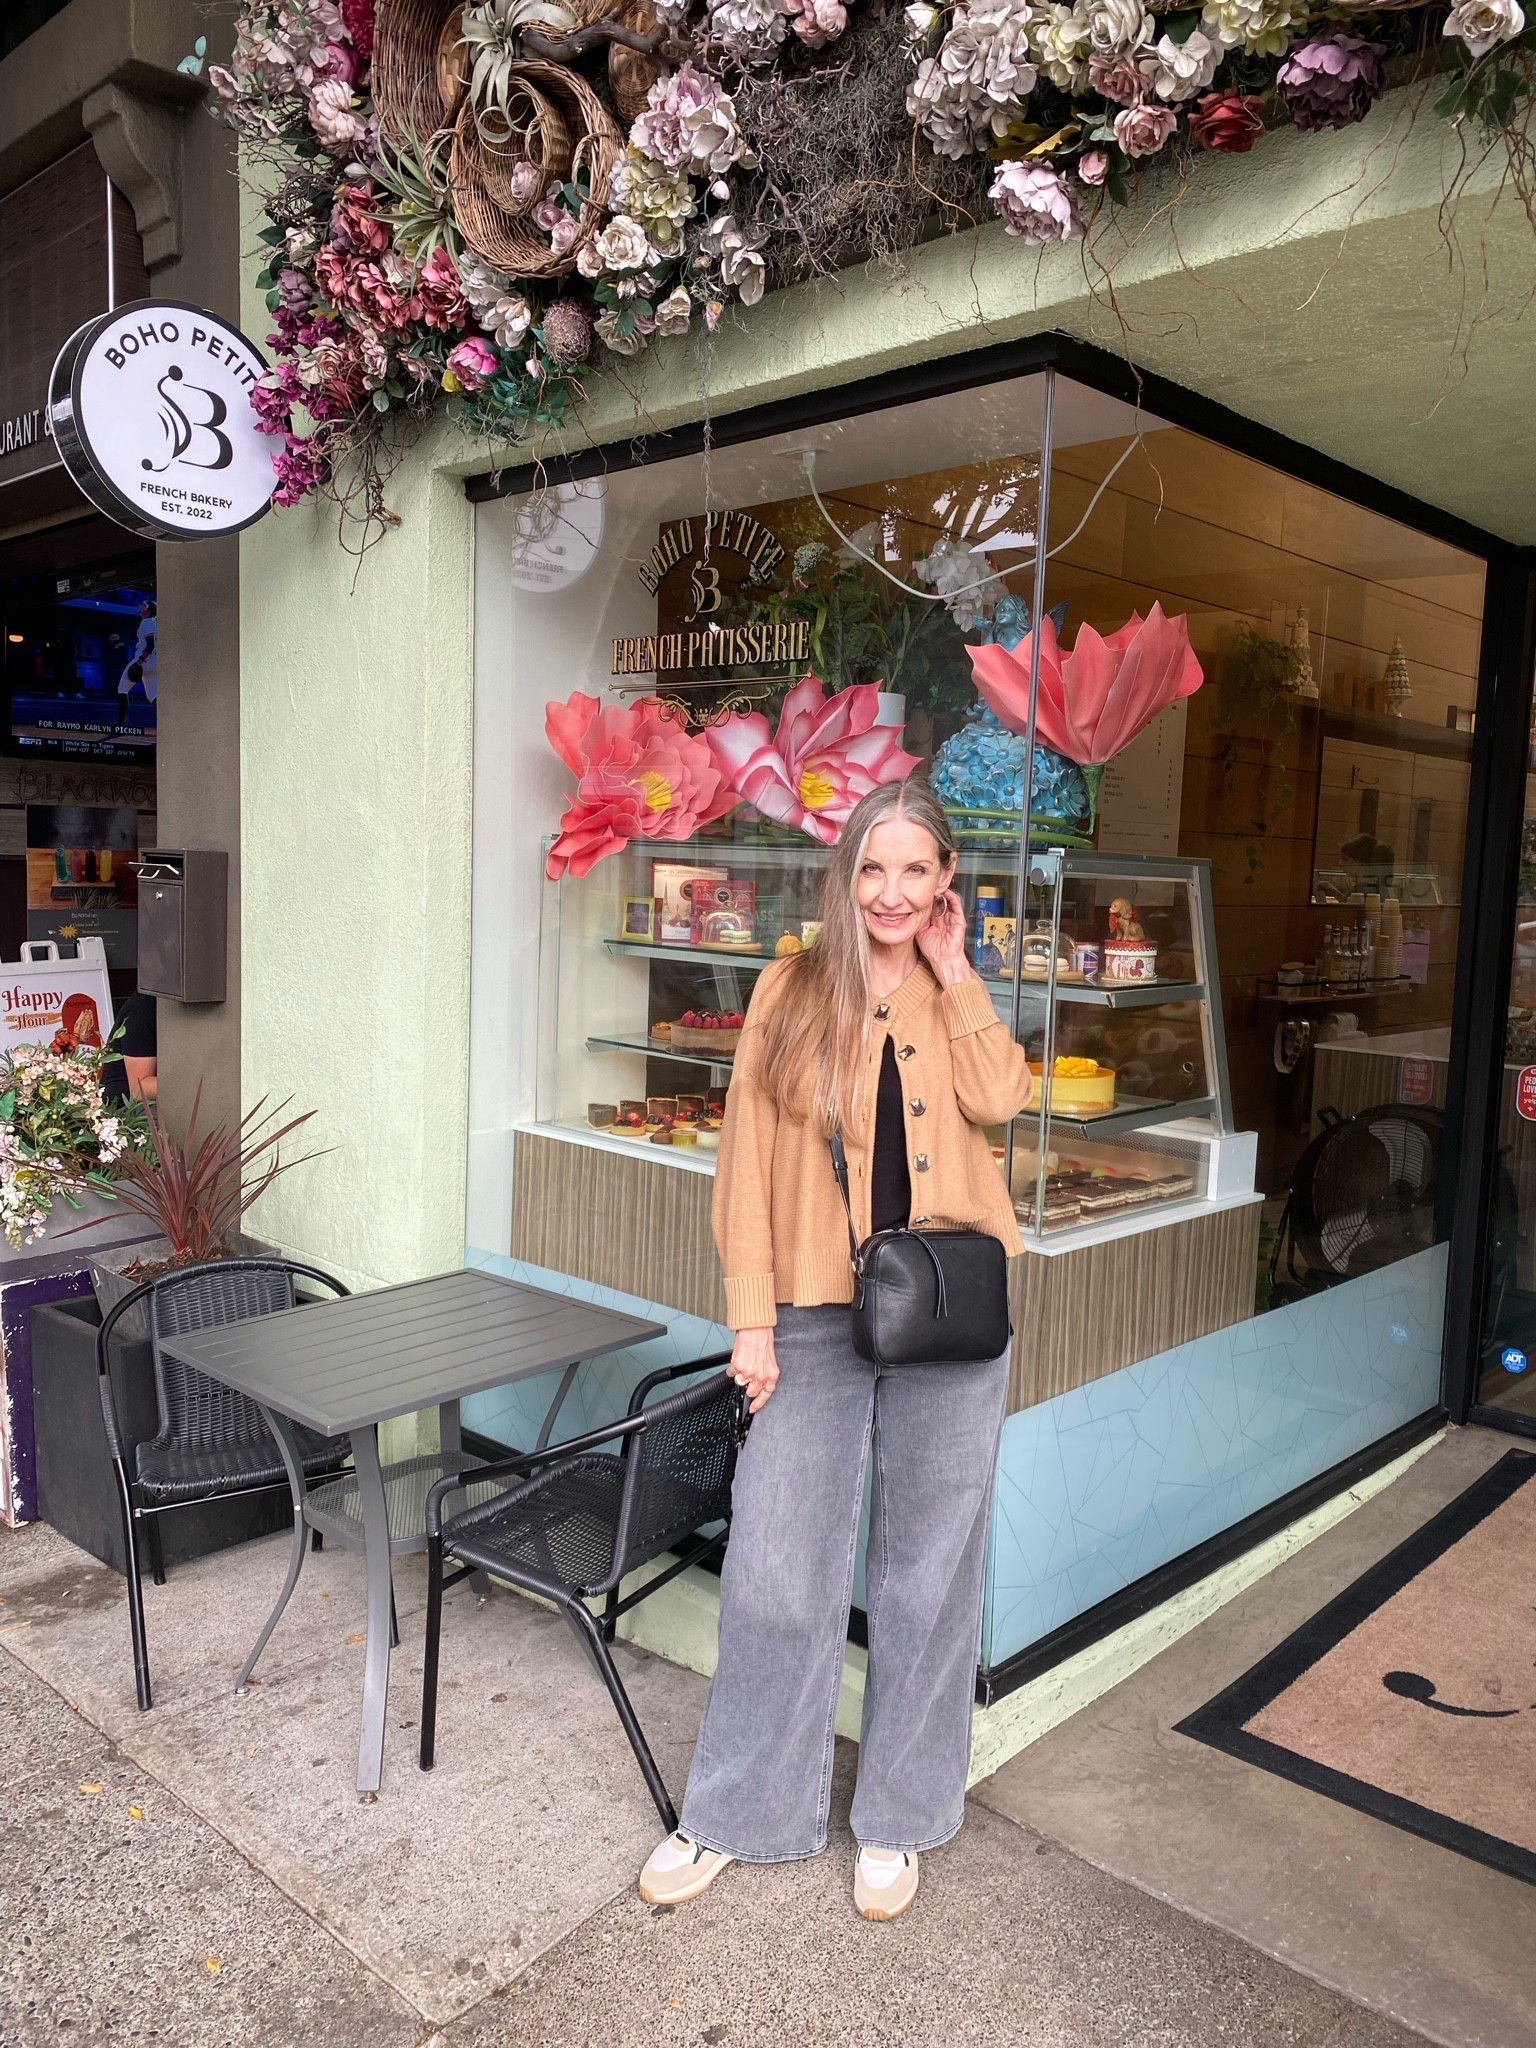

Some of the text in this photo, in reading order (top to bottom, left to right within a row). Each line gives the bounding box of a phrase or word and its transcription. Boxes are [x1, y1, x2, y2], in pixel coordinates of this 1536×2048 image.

[104, 321, 257, 398] BOHO PETIT
[140, 482, 233, 509] FRENCH BAKERY
[161, 501, 213, 520] EST. 2022
[637, 510, 787, 598] BOHO PETITE
[611, 620, 811, 674] FRENCH PATISSERIE
[38, 720, 142, 735] FOR RAYMO KARLYN PICKEN
[19, 737, 42, 746] ESPN
[98, 742, 114, 750] Tigers
[1, 985, 63, 1012] Happy
[14, 1012, 48, 1031] Hour
[1505, 1353, 1524, 1364] ADT
